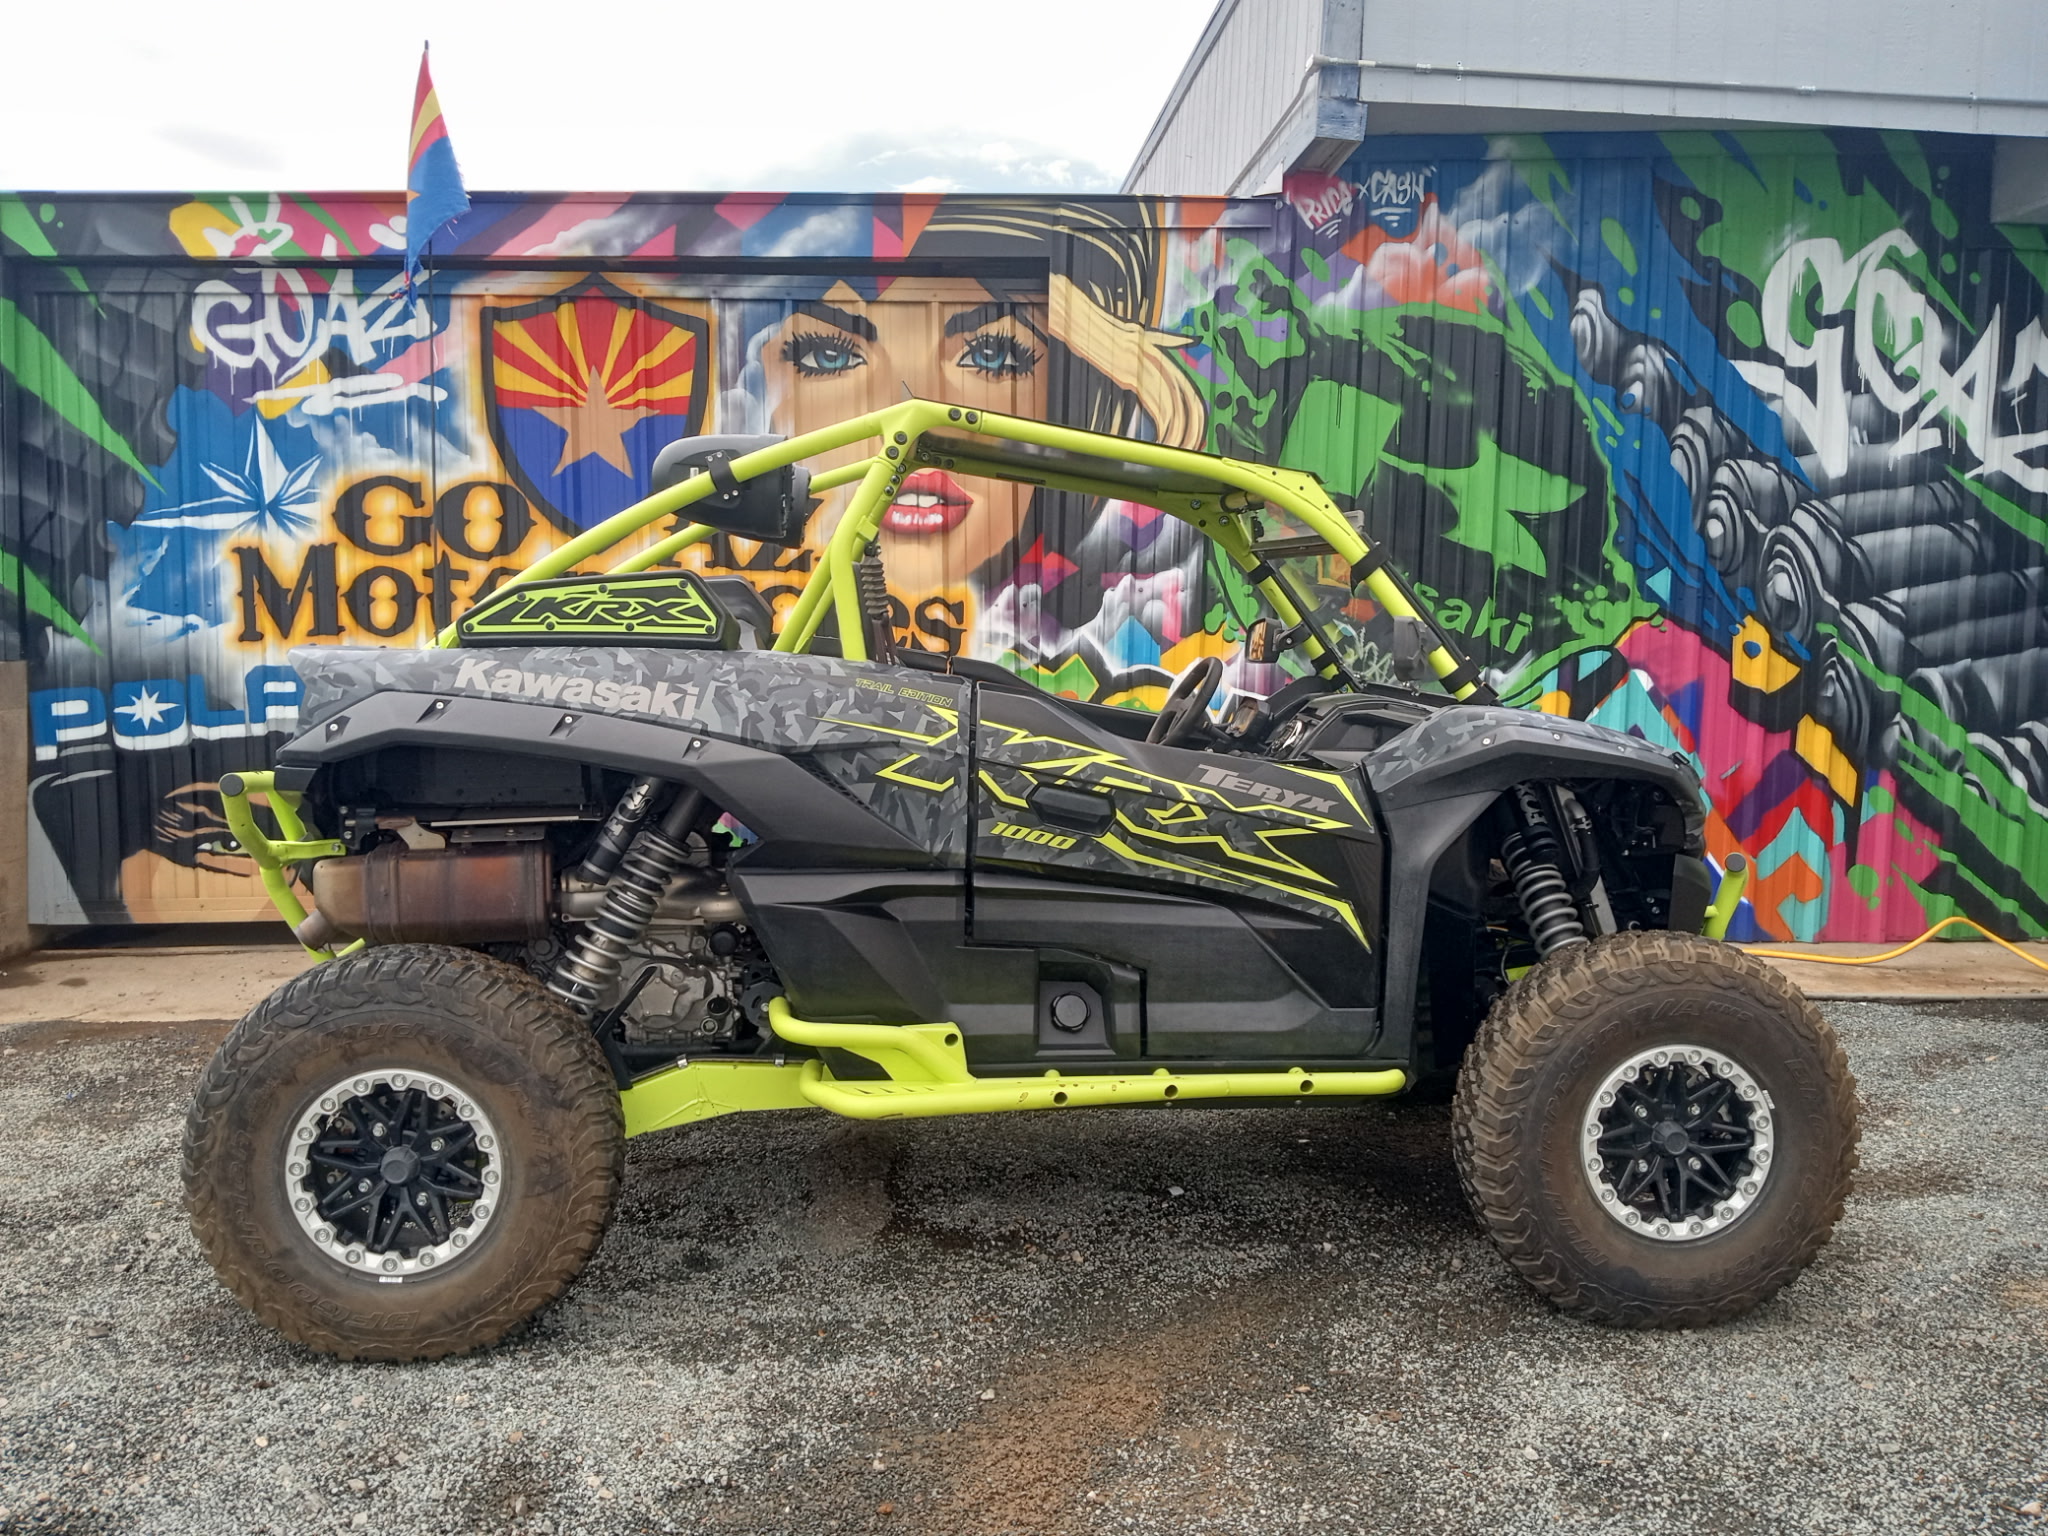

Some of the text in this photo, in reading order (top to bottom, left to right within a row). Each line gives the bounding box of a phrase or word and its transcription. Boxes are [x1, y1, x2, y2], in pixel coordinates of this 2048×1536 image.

[331, 475, 538, 561] GO
[513, 594, 706, 626] KRX
[453, 657, 700, 721] Kawasaki
[855, 677, 953, 707] TRAIL EDITION
[989, 820, 1077, 850] 1000
[229, 1129, 420, 1331] BFGoodrich
